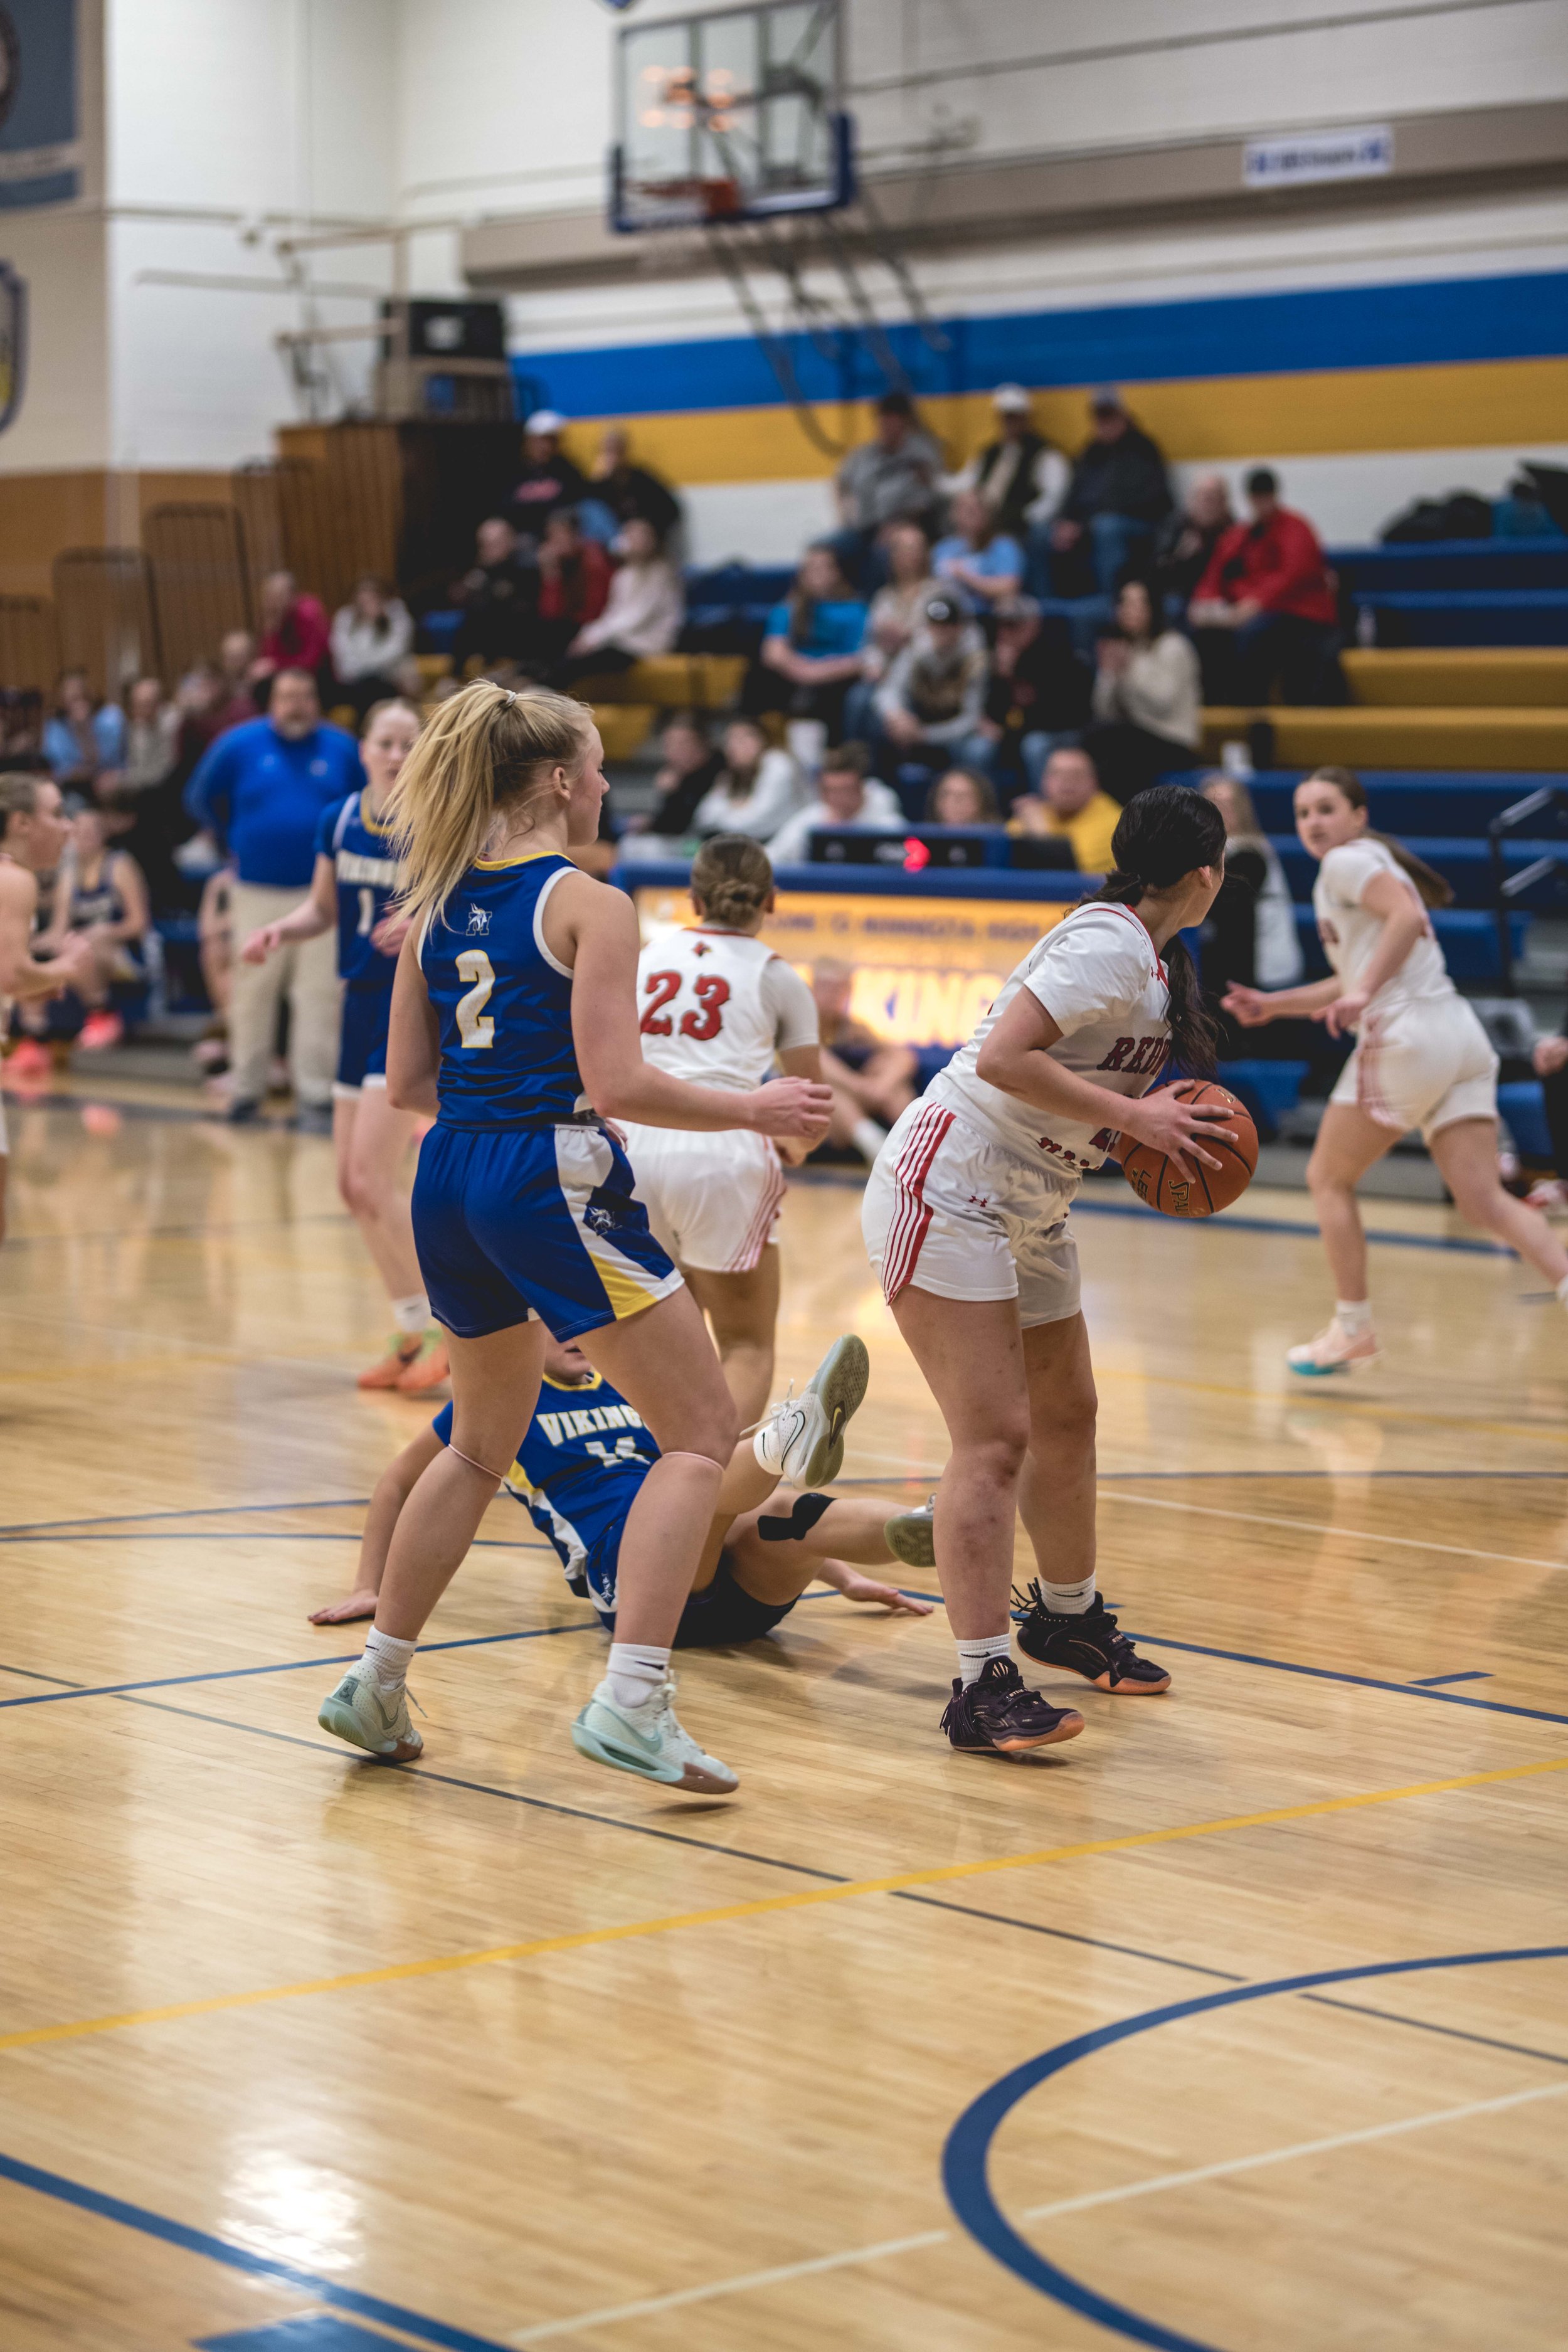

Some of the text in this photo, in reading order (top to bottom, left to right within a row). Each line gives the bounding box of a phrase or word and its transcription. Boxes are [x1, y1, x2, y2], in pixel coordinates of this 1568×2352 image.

[455, 949, 495, 1049] 2
[640, 970, 731, 1041] 23
[536, 1404, 650, 1447] VIKING
[585, 1436, 652, 1468] 14
